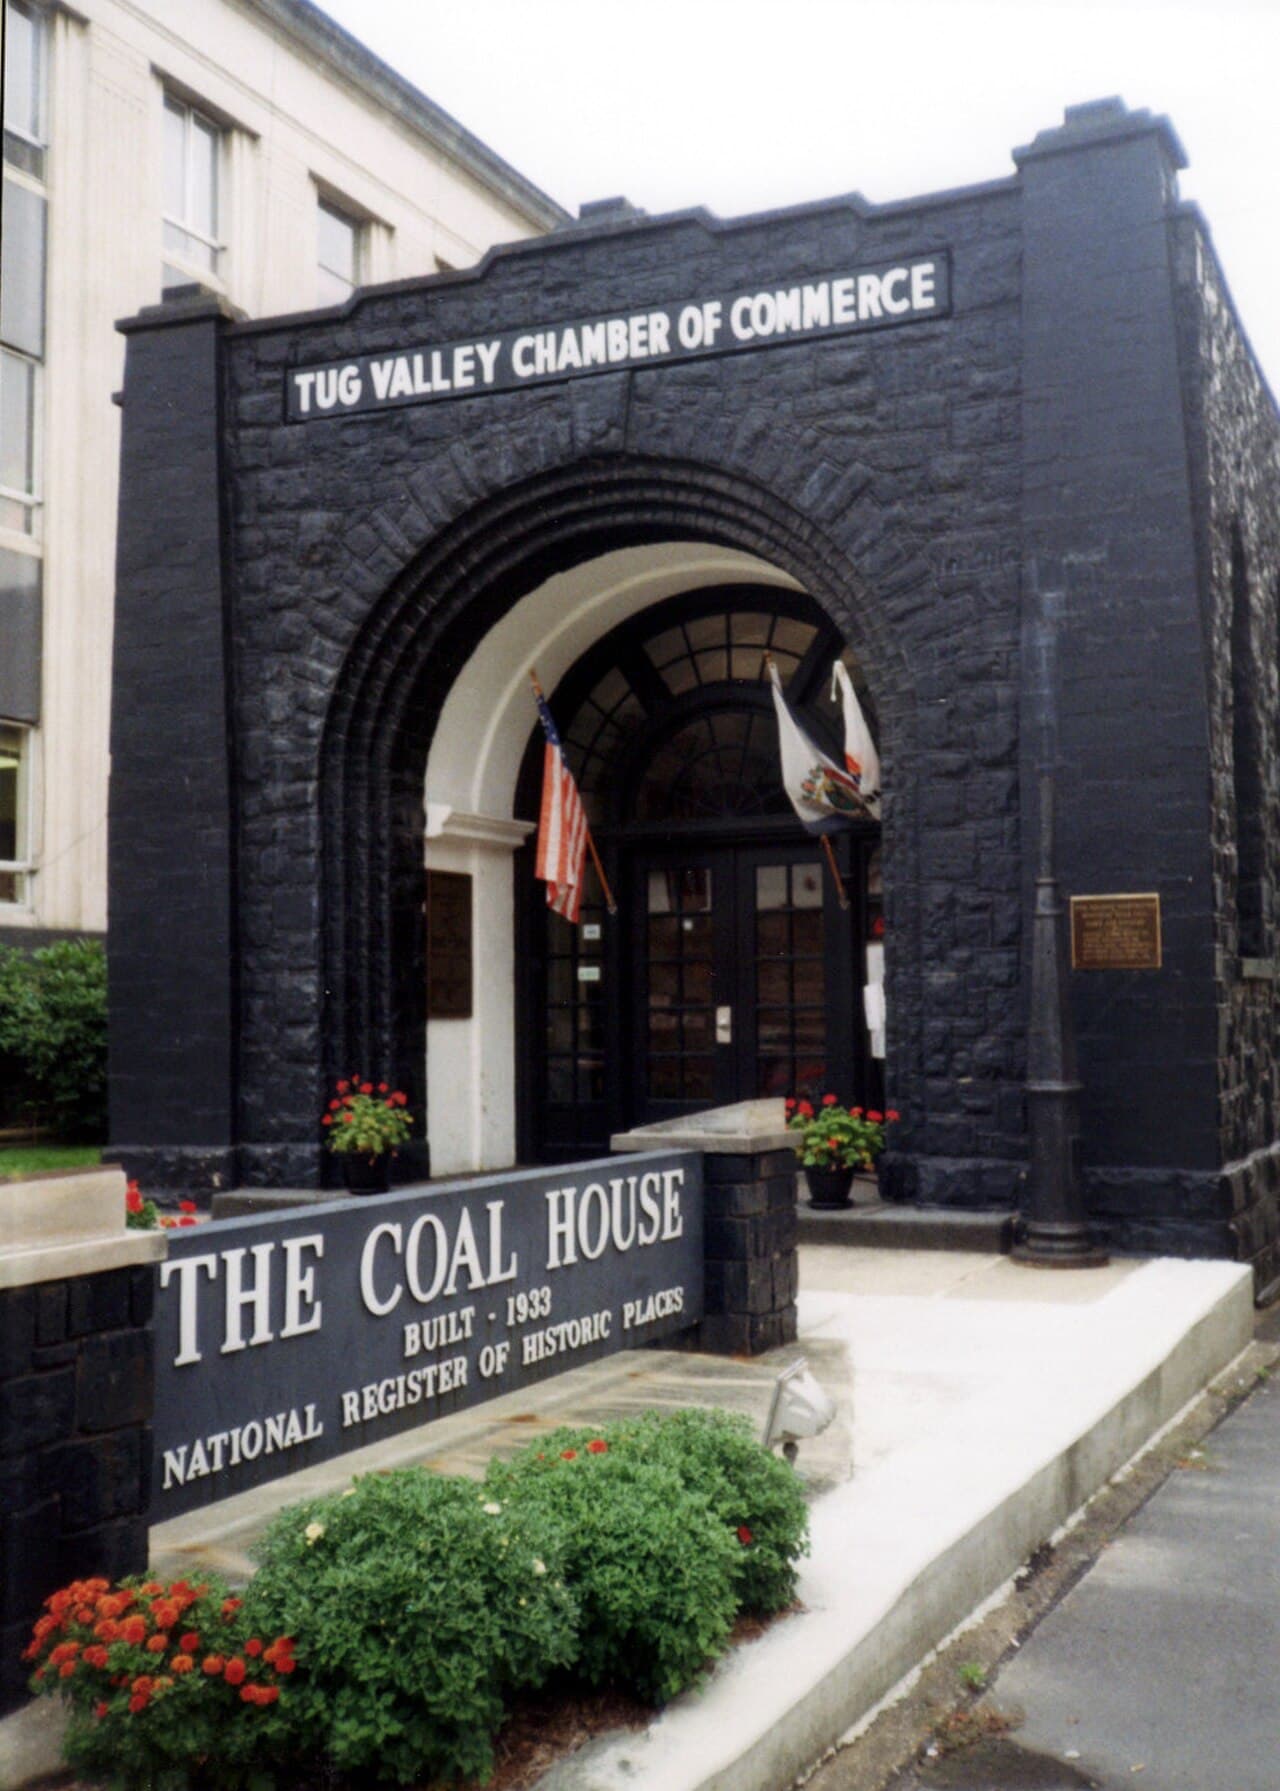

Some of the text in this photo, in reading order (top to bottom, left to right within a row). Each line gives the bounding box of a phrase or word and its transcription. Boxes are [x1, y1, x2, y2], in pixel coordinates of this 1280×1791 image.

[295, 263, 935, 413] TUG VALLEY CHAMBER OF COMMERCE
[160, 1169, 685, 1367] THE COAL HOUSE
[404, 1306, 476, 1357] BUILT
[506, 1286, 552, 1328] 1933
[162, 1286, 684, 1490] NATIONAL REGISTER OF HISTORIC PLACES
